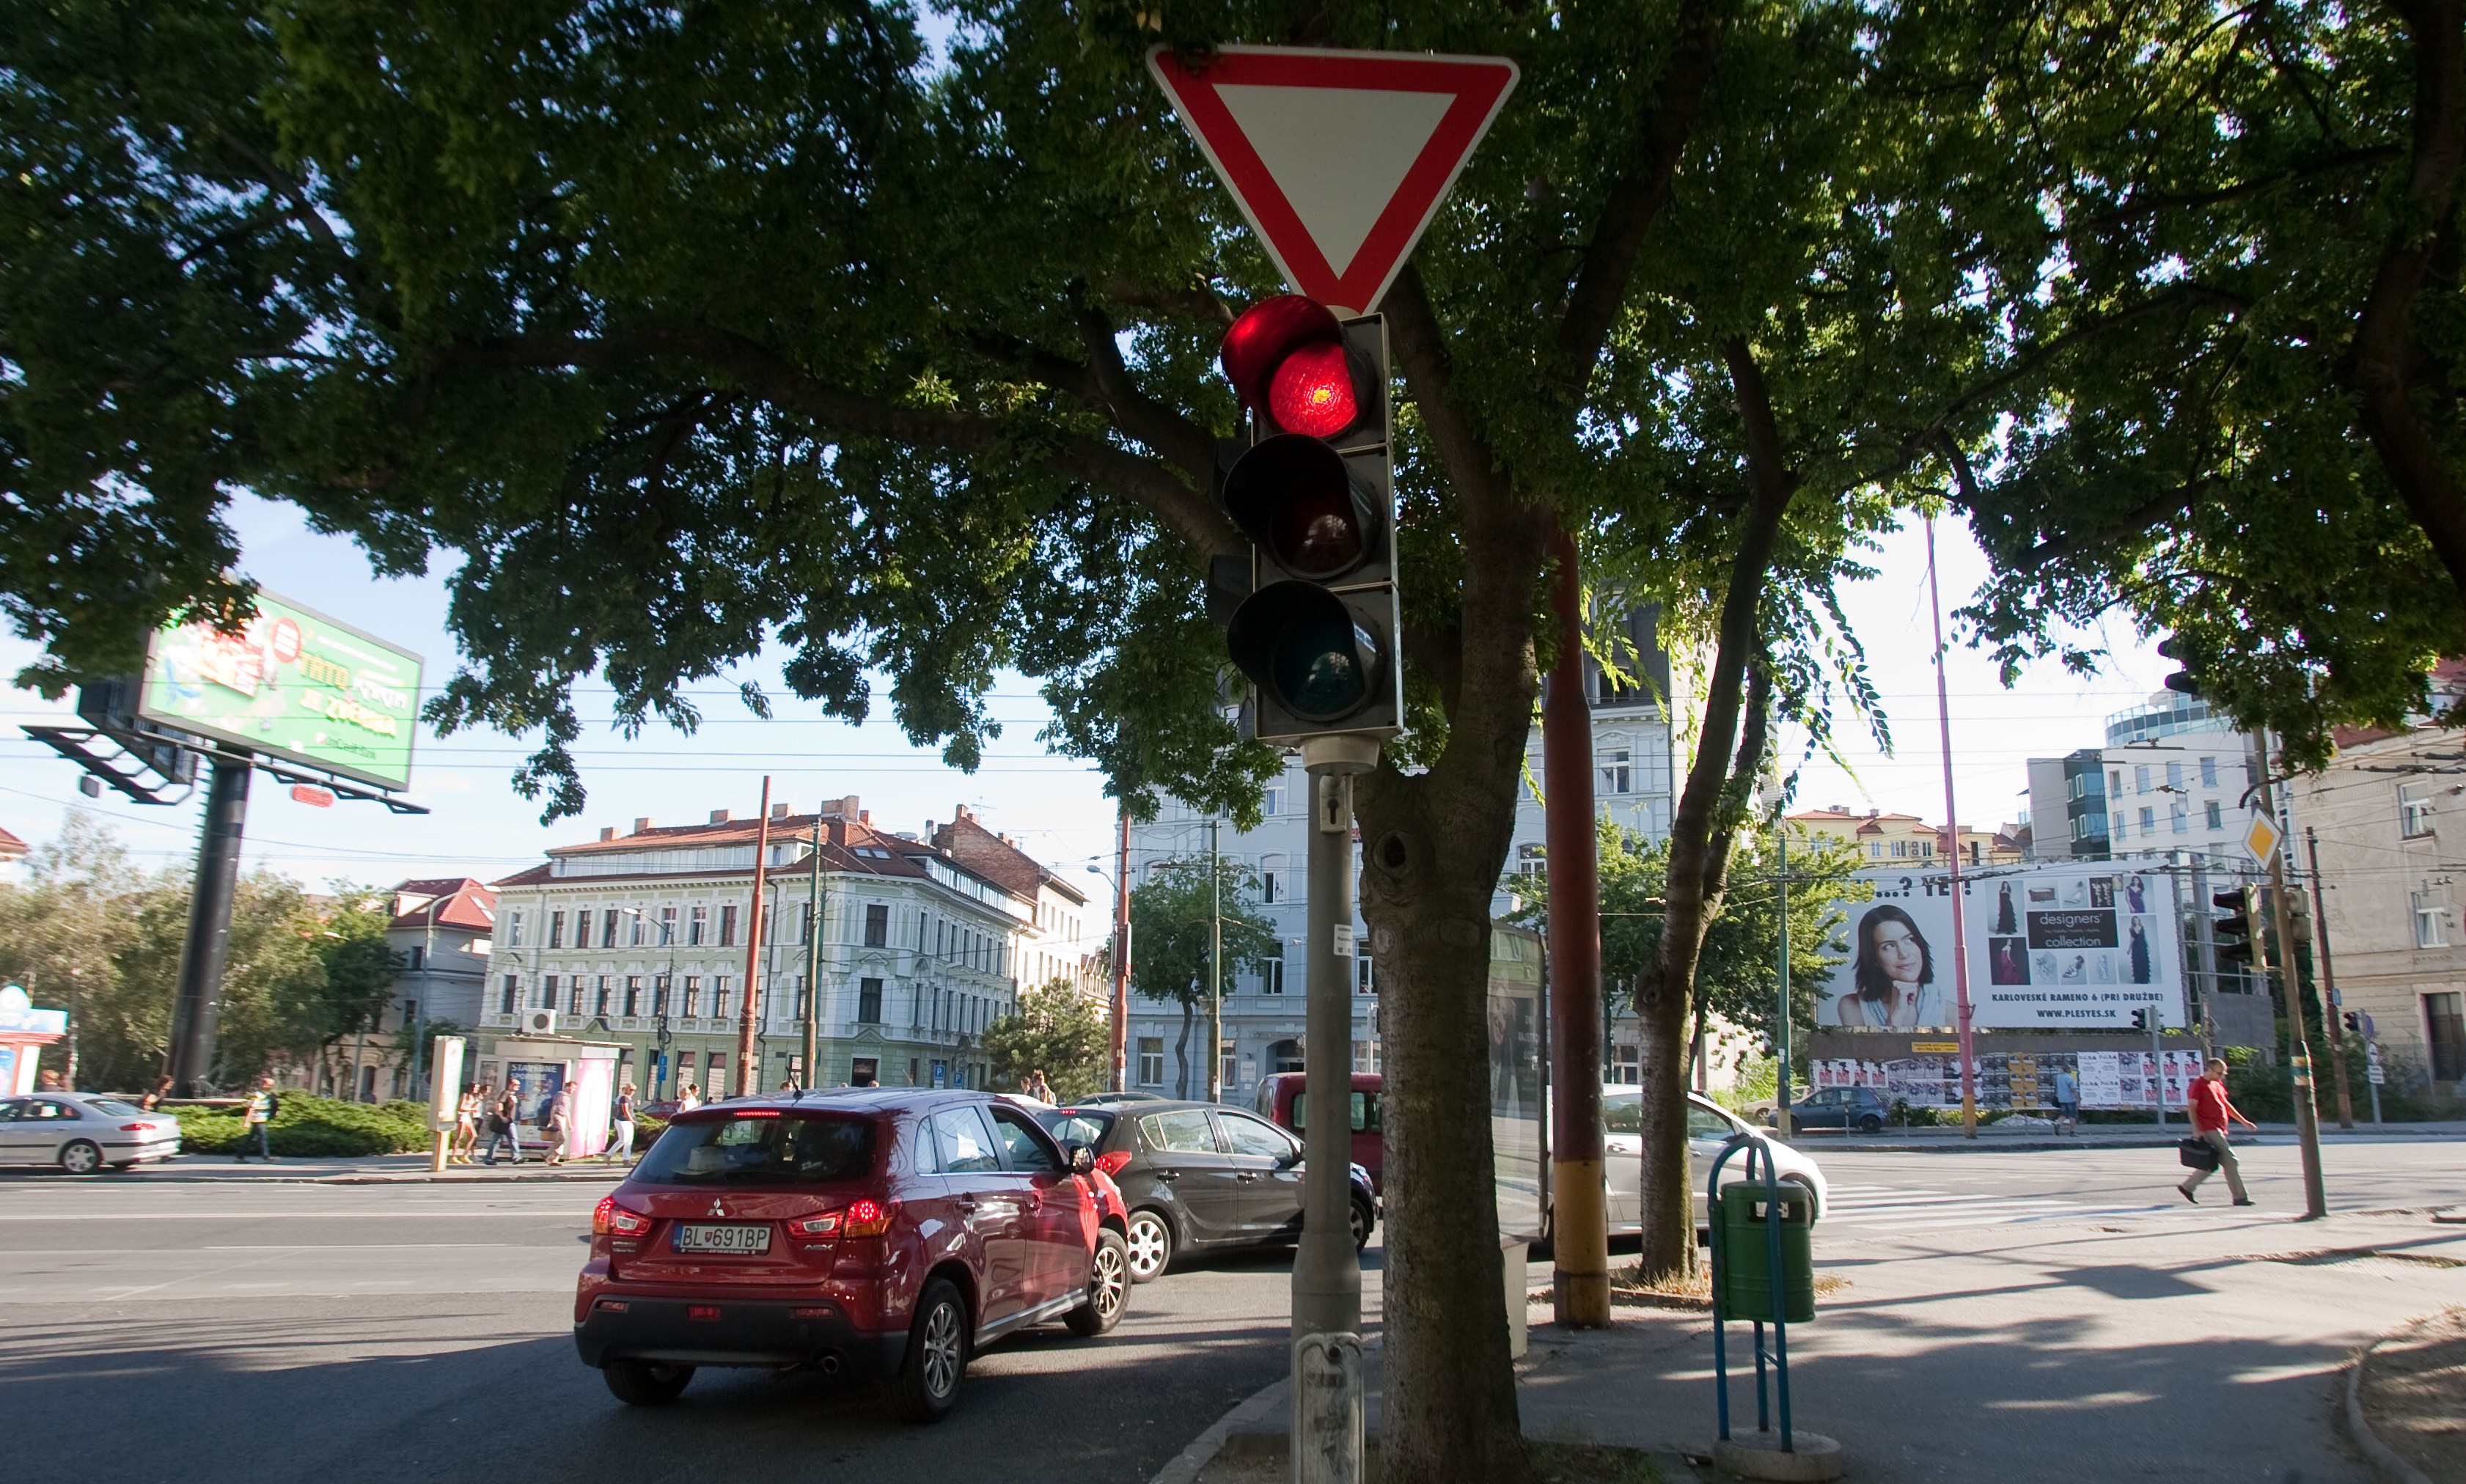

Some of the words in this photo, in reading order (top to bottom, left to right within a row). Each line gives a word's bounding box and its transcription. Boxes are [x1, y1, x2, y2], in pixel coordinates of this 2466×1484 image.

[2045, 935, 2102, 947] collection
[1992, 992, 2047, 1002] KARLOVESKÉ
[2050, 993, 2088, 1002] RAMENO
[2091, 993, 2097, 1002] 6
[2101, 993, 2120, 1002] (PRI
[2123, 992, 2163, 1002] DRUŽBE)
[2036, 1010, 2117, 1018] WWW.PLESYES.SK
[683, 1228, 702, 1246] BL
[713, 1228, 767, 1248] 691BP
